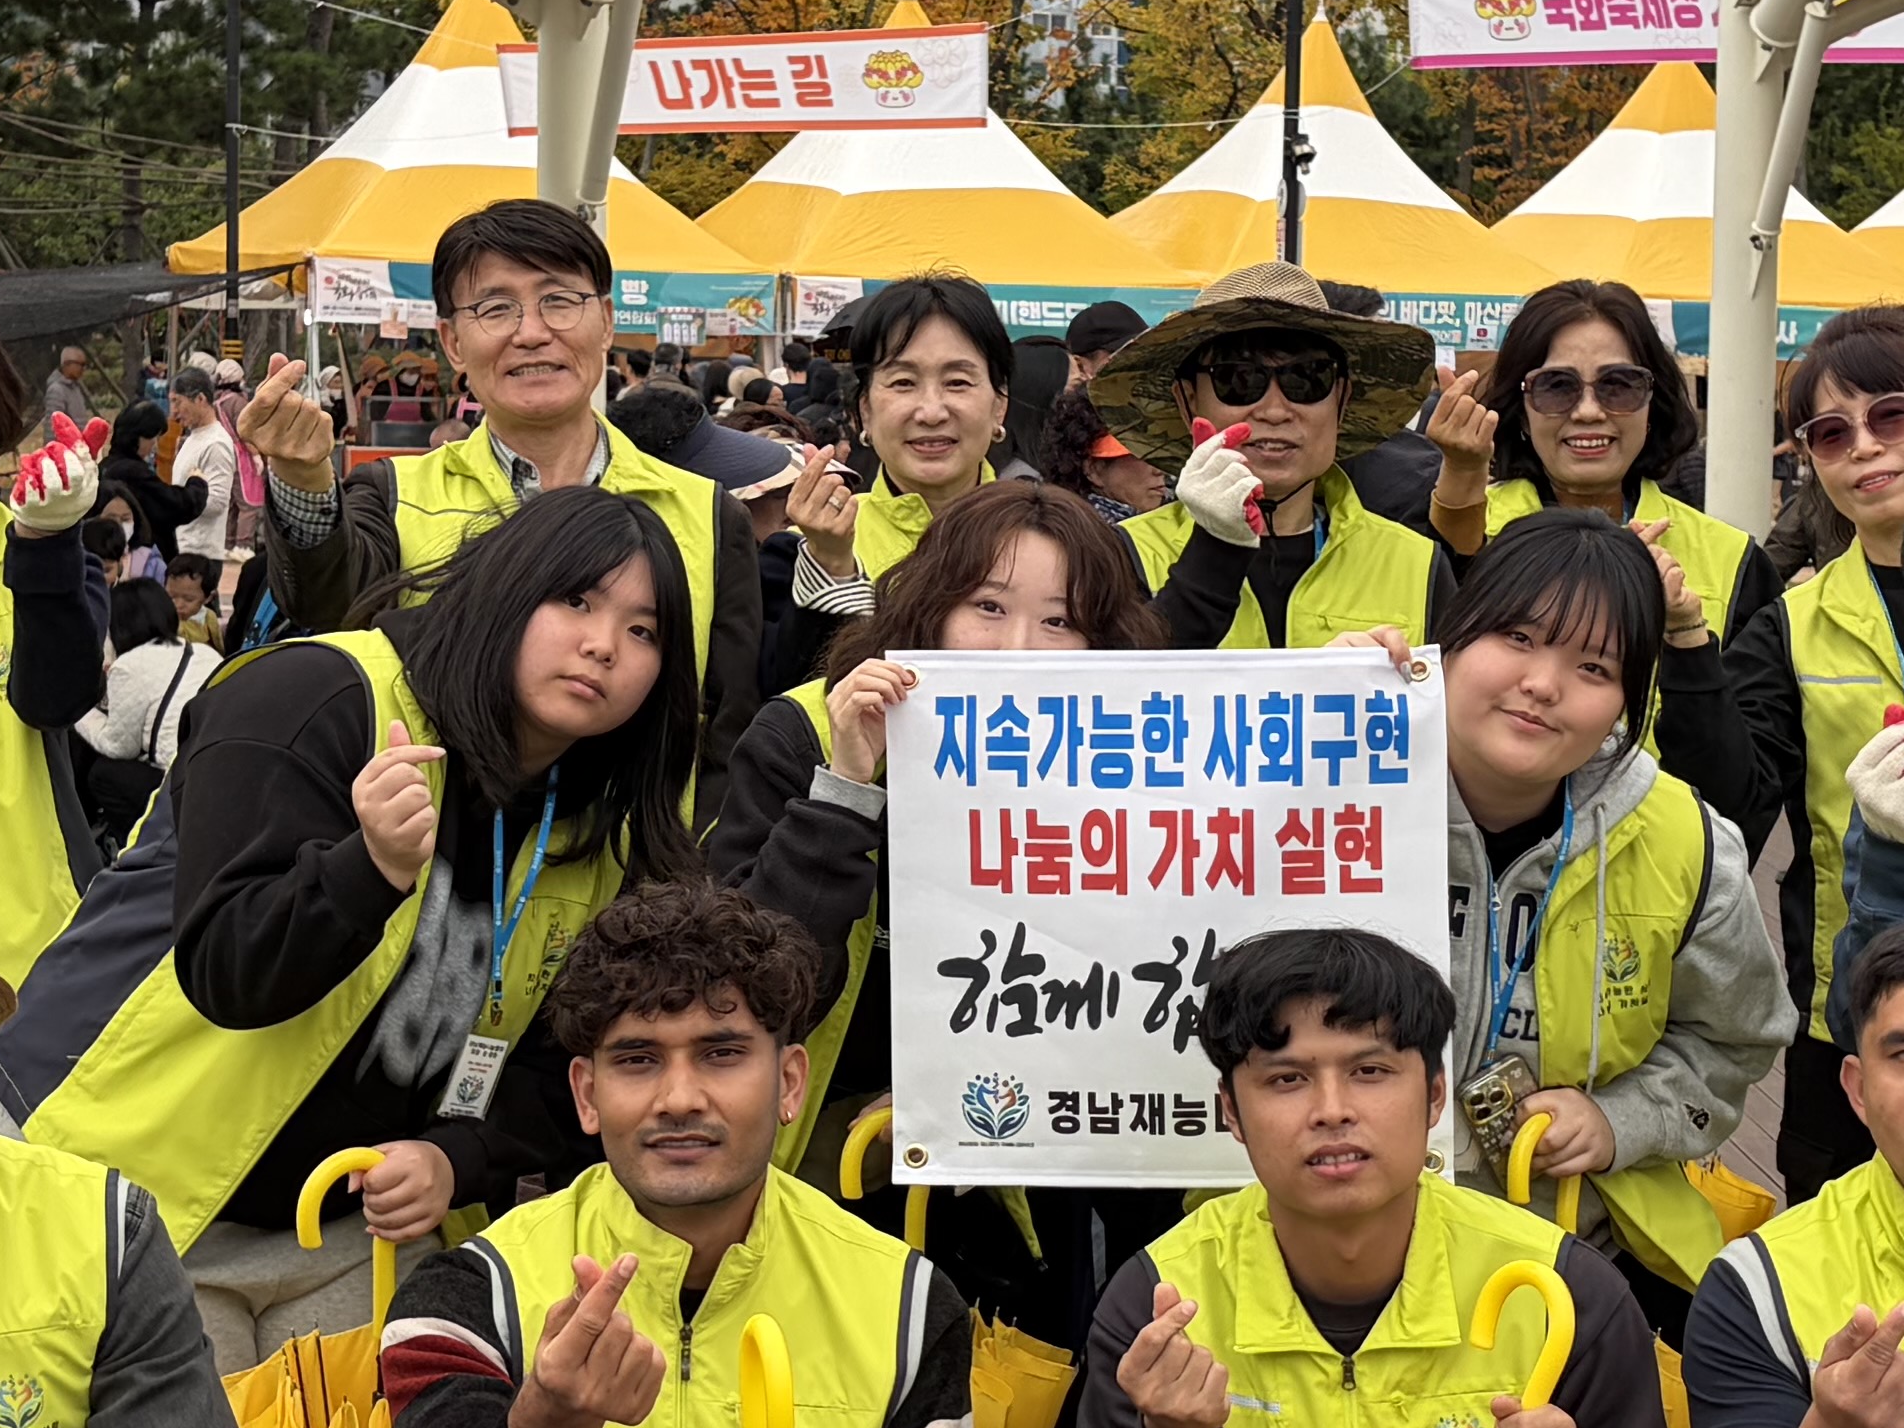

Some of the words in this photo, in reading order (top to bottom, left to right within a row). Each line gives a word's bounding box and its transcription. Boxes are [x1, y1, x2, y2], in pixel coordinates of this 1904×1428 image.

[649, 56, 781, 110] 나가는
[790, 54, 834, 108] 길
[934, 691, 1189, 789] 지속가능한
[1203, 689, 1411, 788] 사회구현
[969, 808, 1128, 896] 나눔의
[1148, 808, 1256, 897] 가치
[1275, 804, 1384, 896] 실현
[937, 922, 1120, 1038] 함께
